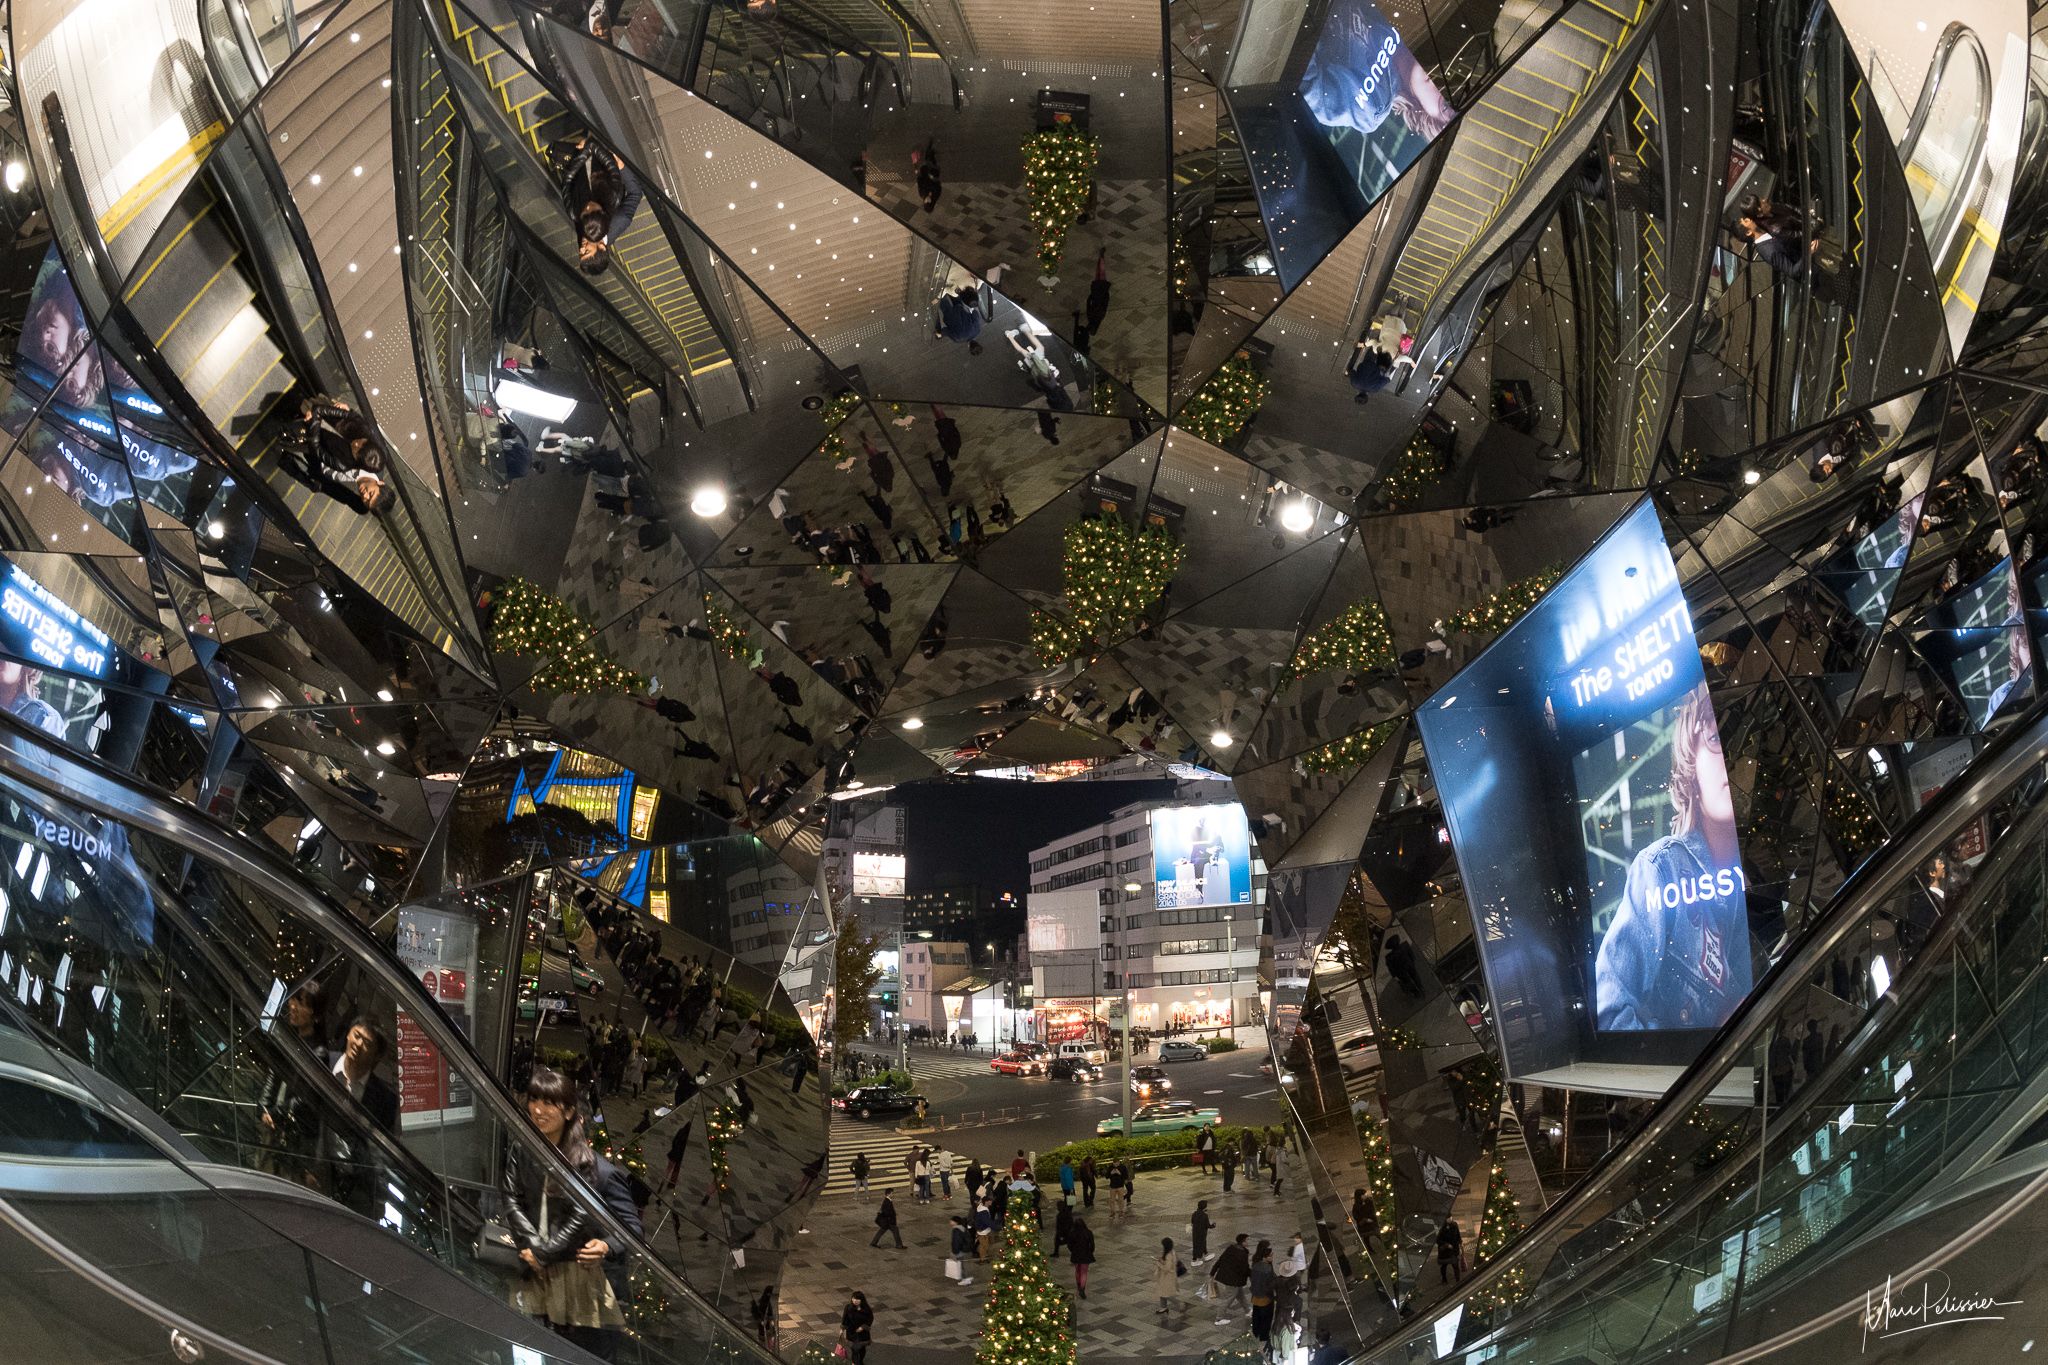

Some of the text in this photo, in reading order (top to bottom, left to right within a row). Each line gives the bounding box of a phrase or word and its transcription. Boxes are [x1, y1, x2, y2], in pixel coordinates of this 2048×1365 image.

[57, 441, 108, 491] MOUSSY
[1571, 665, 1613, 707] The
[1625, 658, 1674, 701] TOKYO
[1645, 866, 1746, 913] MOUSSY
